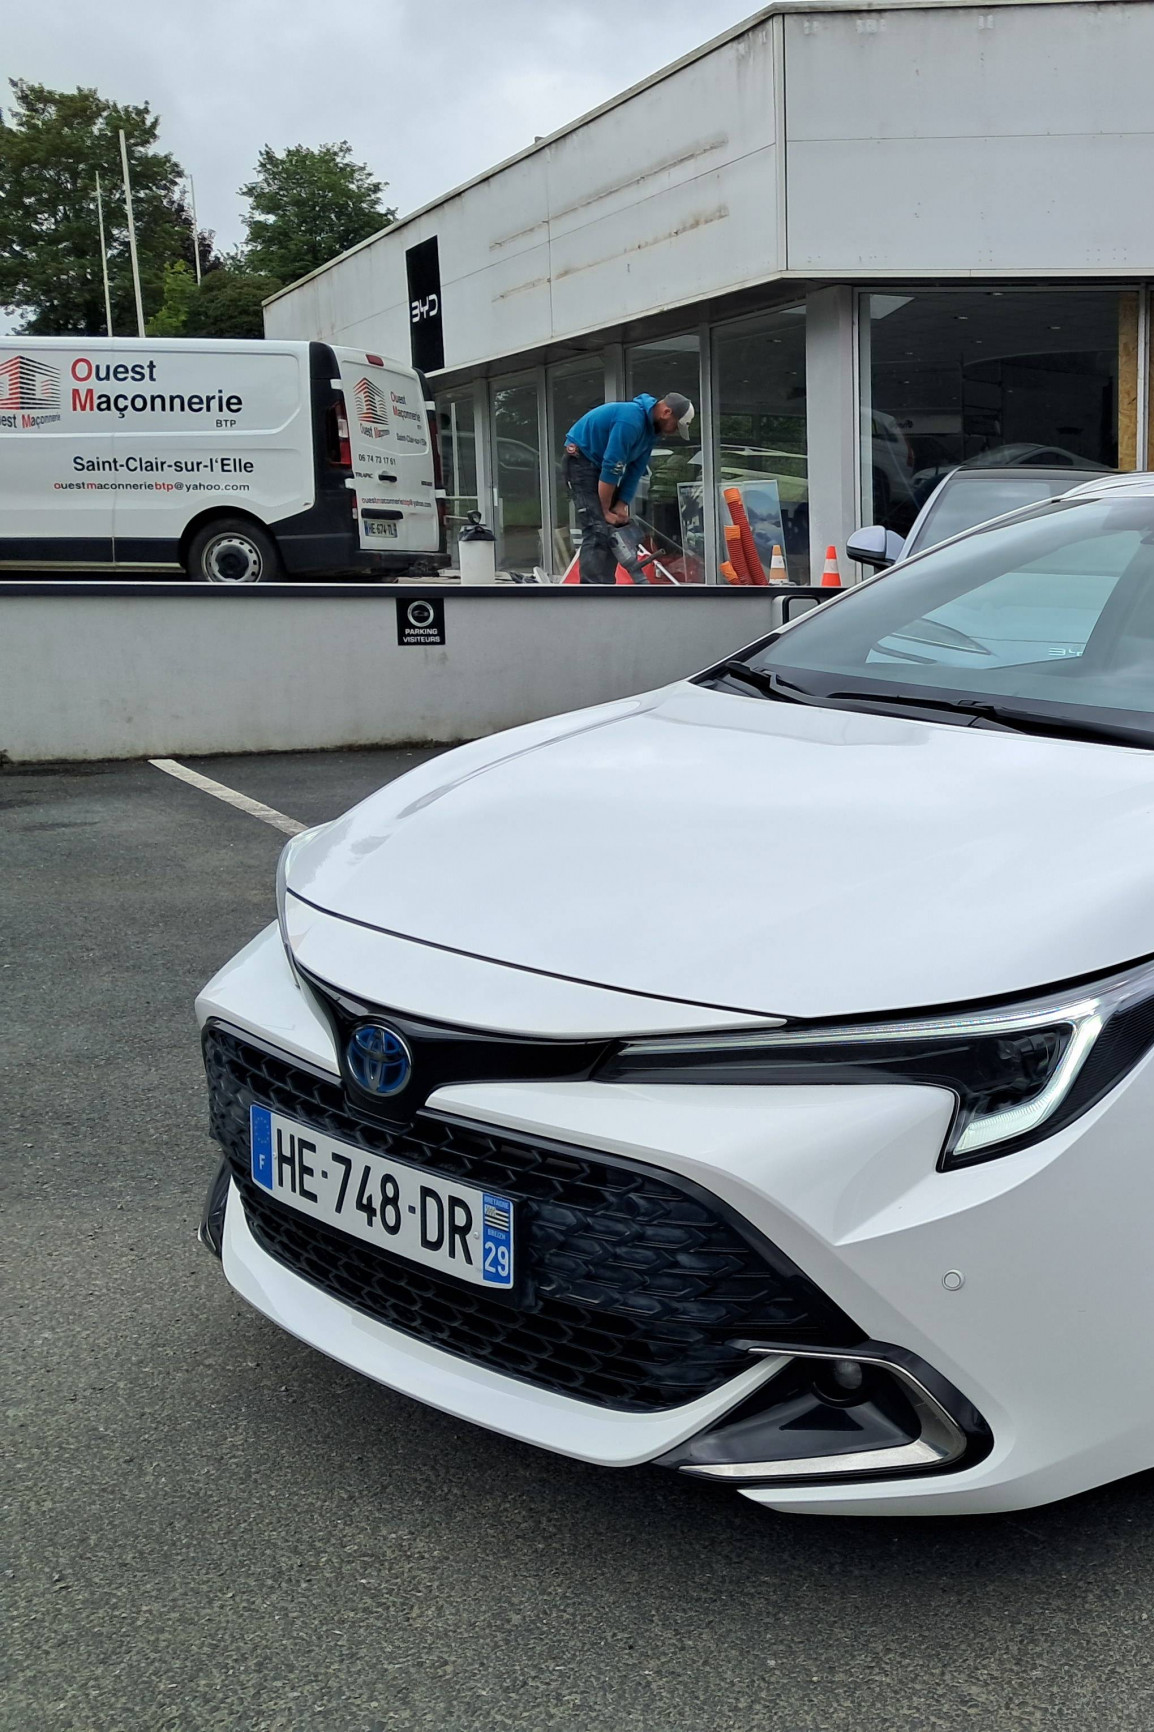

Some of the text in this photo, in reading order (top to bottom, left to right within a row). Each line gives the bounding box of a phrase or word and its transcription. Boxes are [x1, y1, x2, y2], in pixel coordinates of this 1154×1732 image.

[411, 293, 439, 323] BYD
[71, 357, 157, 382] Ouest
[71, 388, 243, 419] Maçonnerie
[215, 419, 237, 428] BTP
[383, 457, 389, 465] 17
[53, 481, 250, 493] ouestmaconneriebtp@yahoo.com
[402, 635, 441, 643] VISITEURS
[258, 1154, 266, 1171] F
[484, 1241, 509, 1277] 29
